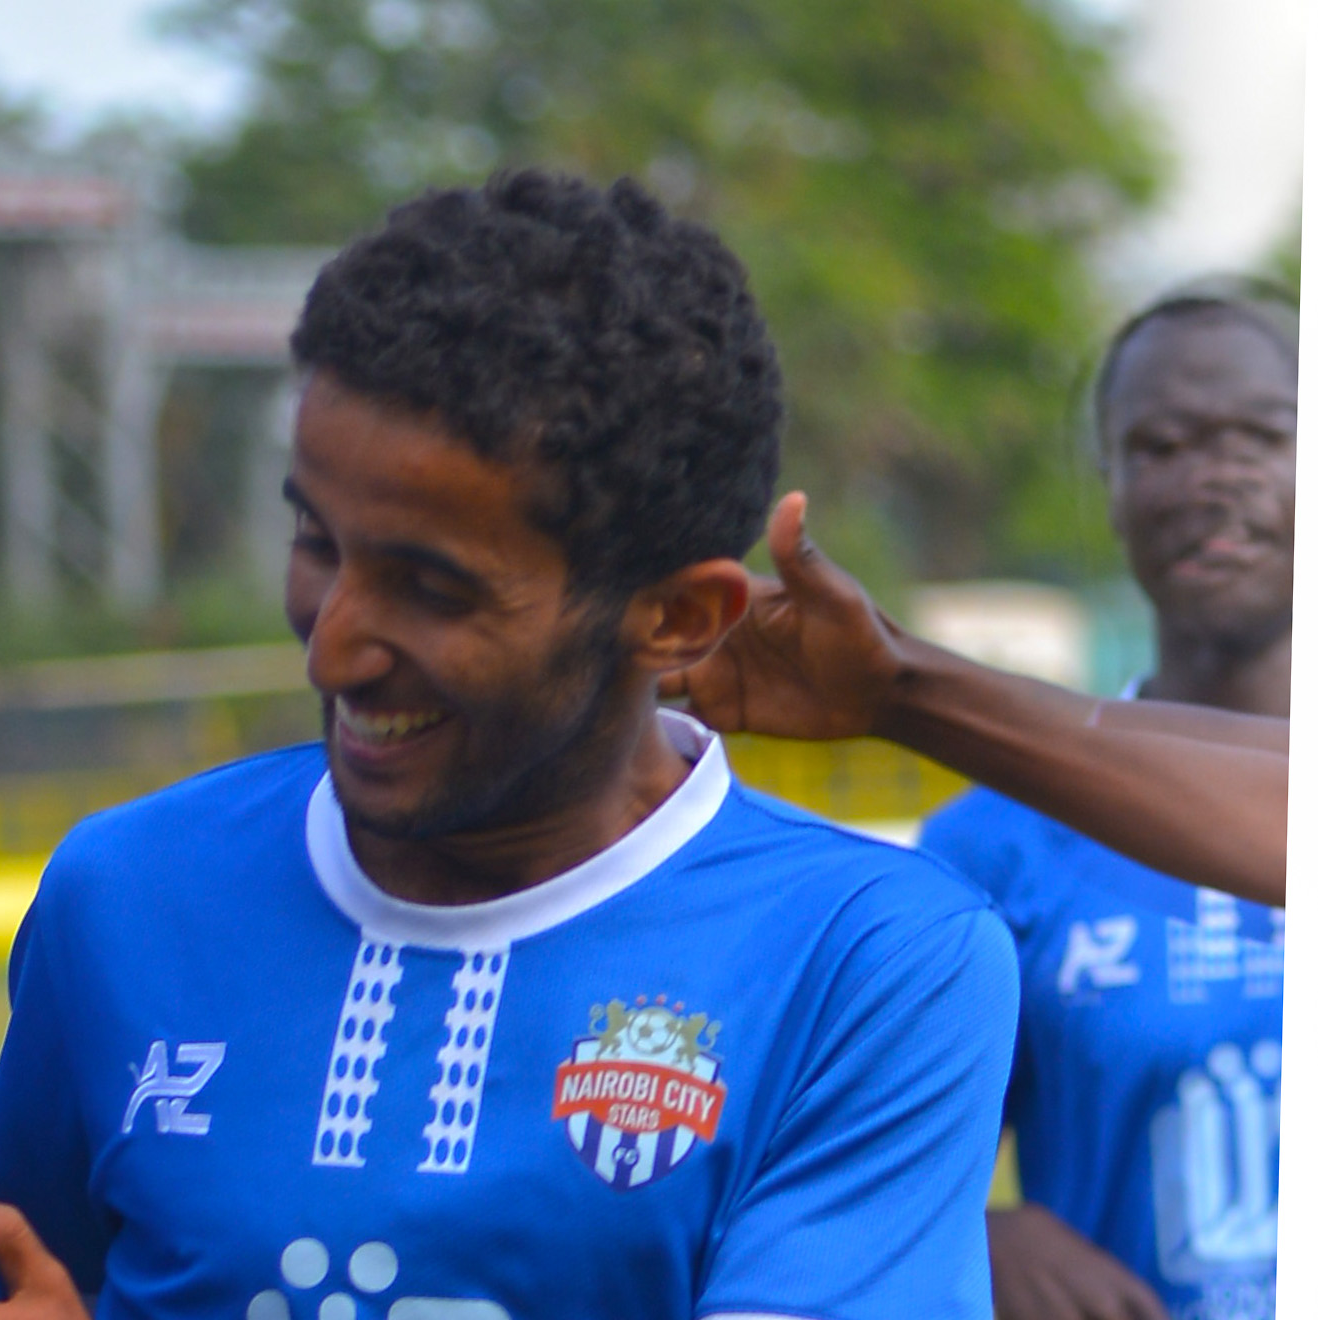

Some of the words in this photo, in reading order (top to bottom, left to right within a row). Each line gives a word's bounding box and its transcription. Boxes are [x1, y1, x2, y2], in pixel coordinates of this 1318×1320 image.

[560, 1070, 659, 1105] NAIROBI
[662, 1079, 716, 1124] CITY
[609, 1103, 660, 1130] STARS
